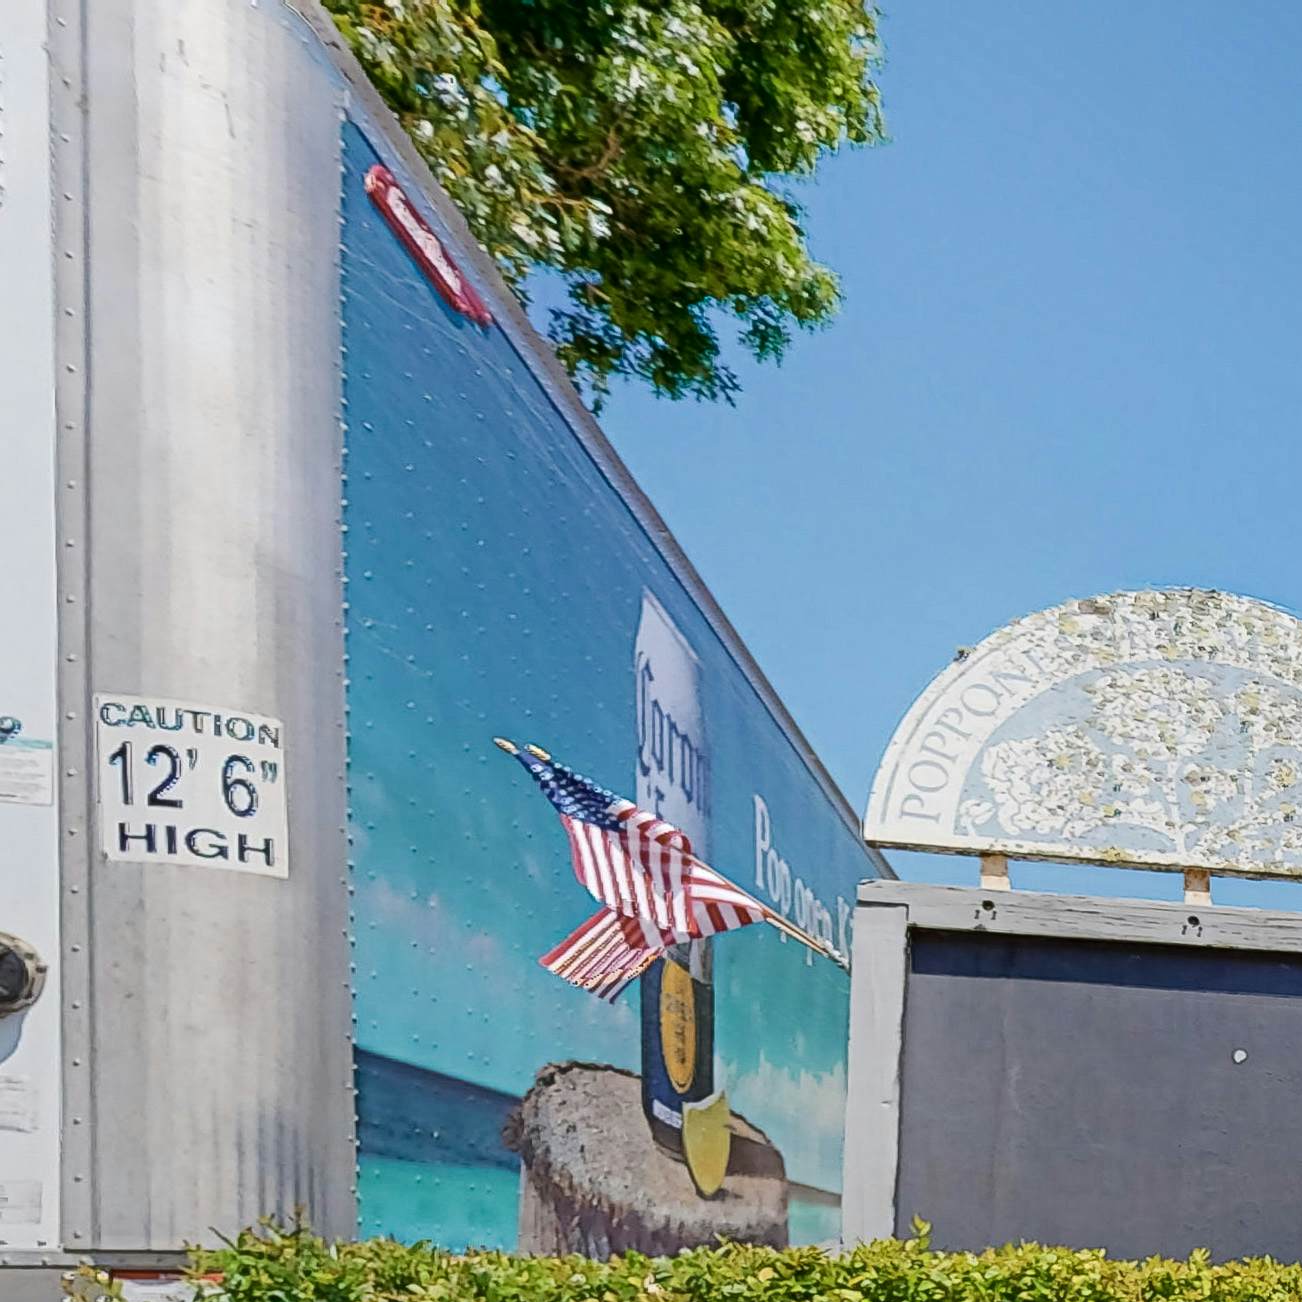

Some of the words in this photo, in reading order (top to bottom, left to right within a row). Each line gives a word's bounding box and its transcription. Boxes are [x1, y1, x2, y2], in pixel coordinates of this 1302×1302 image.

[100, 702, 280, 750] CAUTION
[109, 739, 198, 808] 12'
[223, 754, 277, 818] 6"
[119, 822, 276, 867] HIGH
[754, 794, 792, 943] Pop
